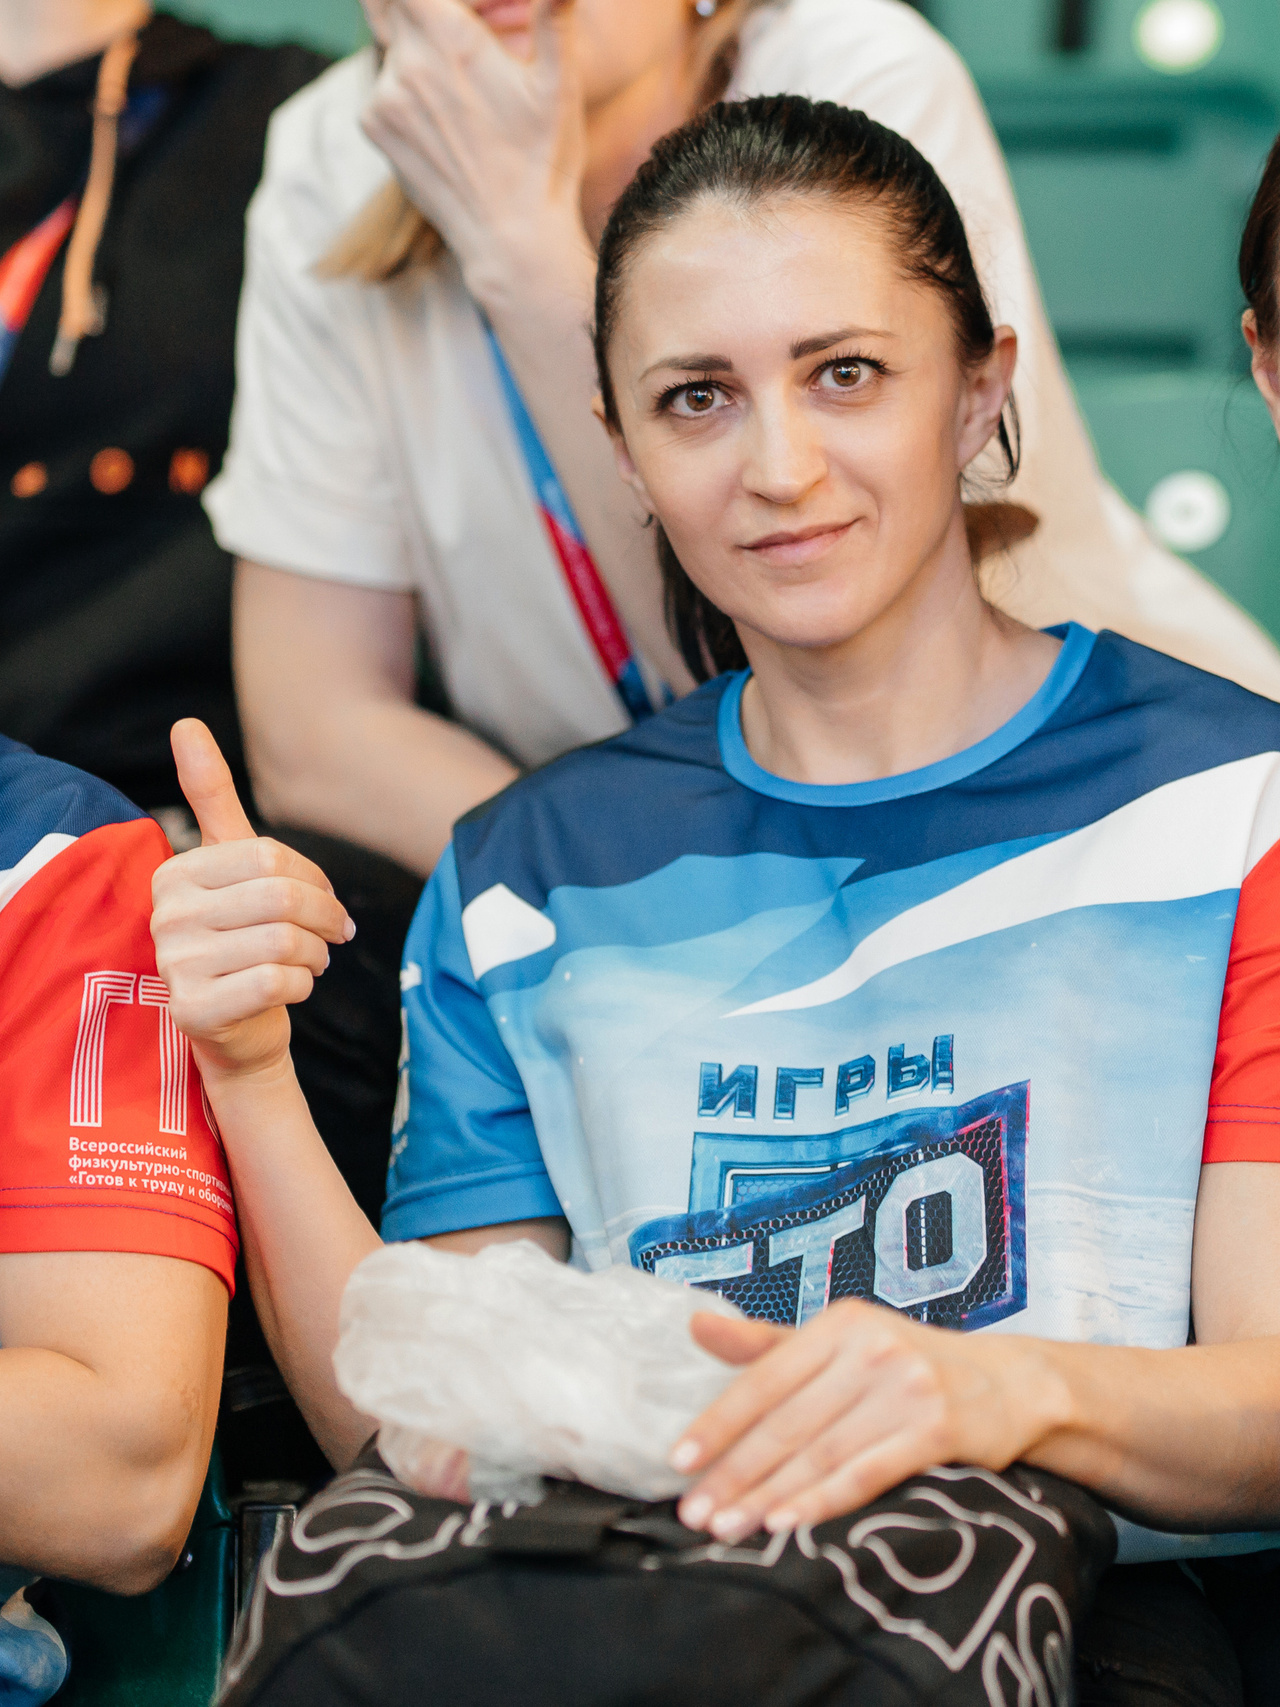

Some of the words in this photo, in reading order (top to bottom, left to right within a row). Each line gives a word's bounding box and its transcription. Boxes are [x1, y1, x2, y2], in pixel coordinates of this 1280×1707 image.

[70, 971, 222, 1145] ГТ
[697, 1034, 954, 1122] ИГРЫ
[68, 1137, 187, 1161] Всероссийский
[69, 1171, 124, 1187] «Готов
[129, 1177, 138, 1188] к
[141, 1178, 185, 1196] труду
[188, 1186, 195, 1197] и
